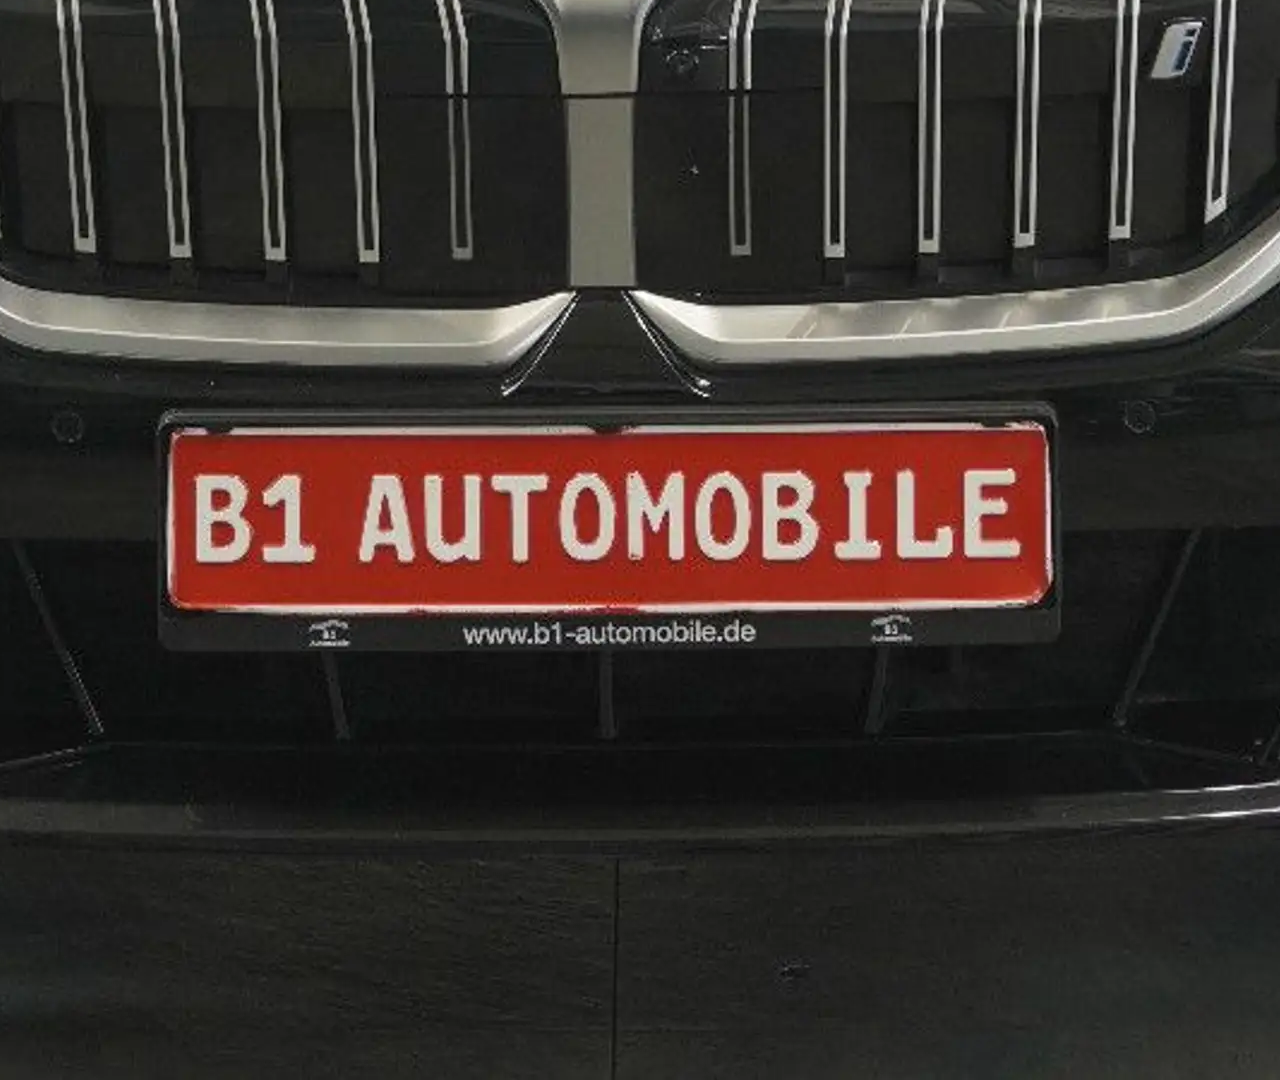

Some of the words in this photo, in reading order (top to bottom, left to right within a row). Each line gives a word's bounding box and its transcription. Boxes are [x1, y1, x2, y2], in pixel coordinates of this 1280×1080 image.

[195, 475, 316, 562] B1
[359, 468, 1020, 562] AUTOMOBILE
[463, 621, 757, 645] www.b1-automobile.de
